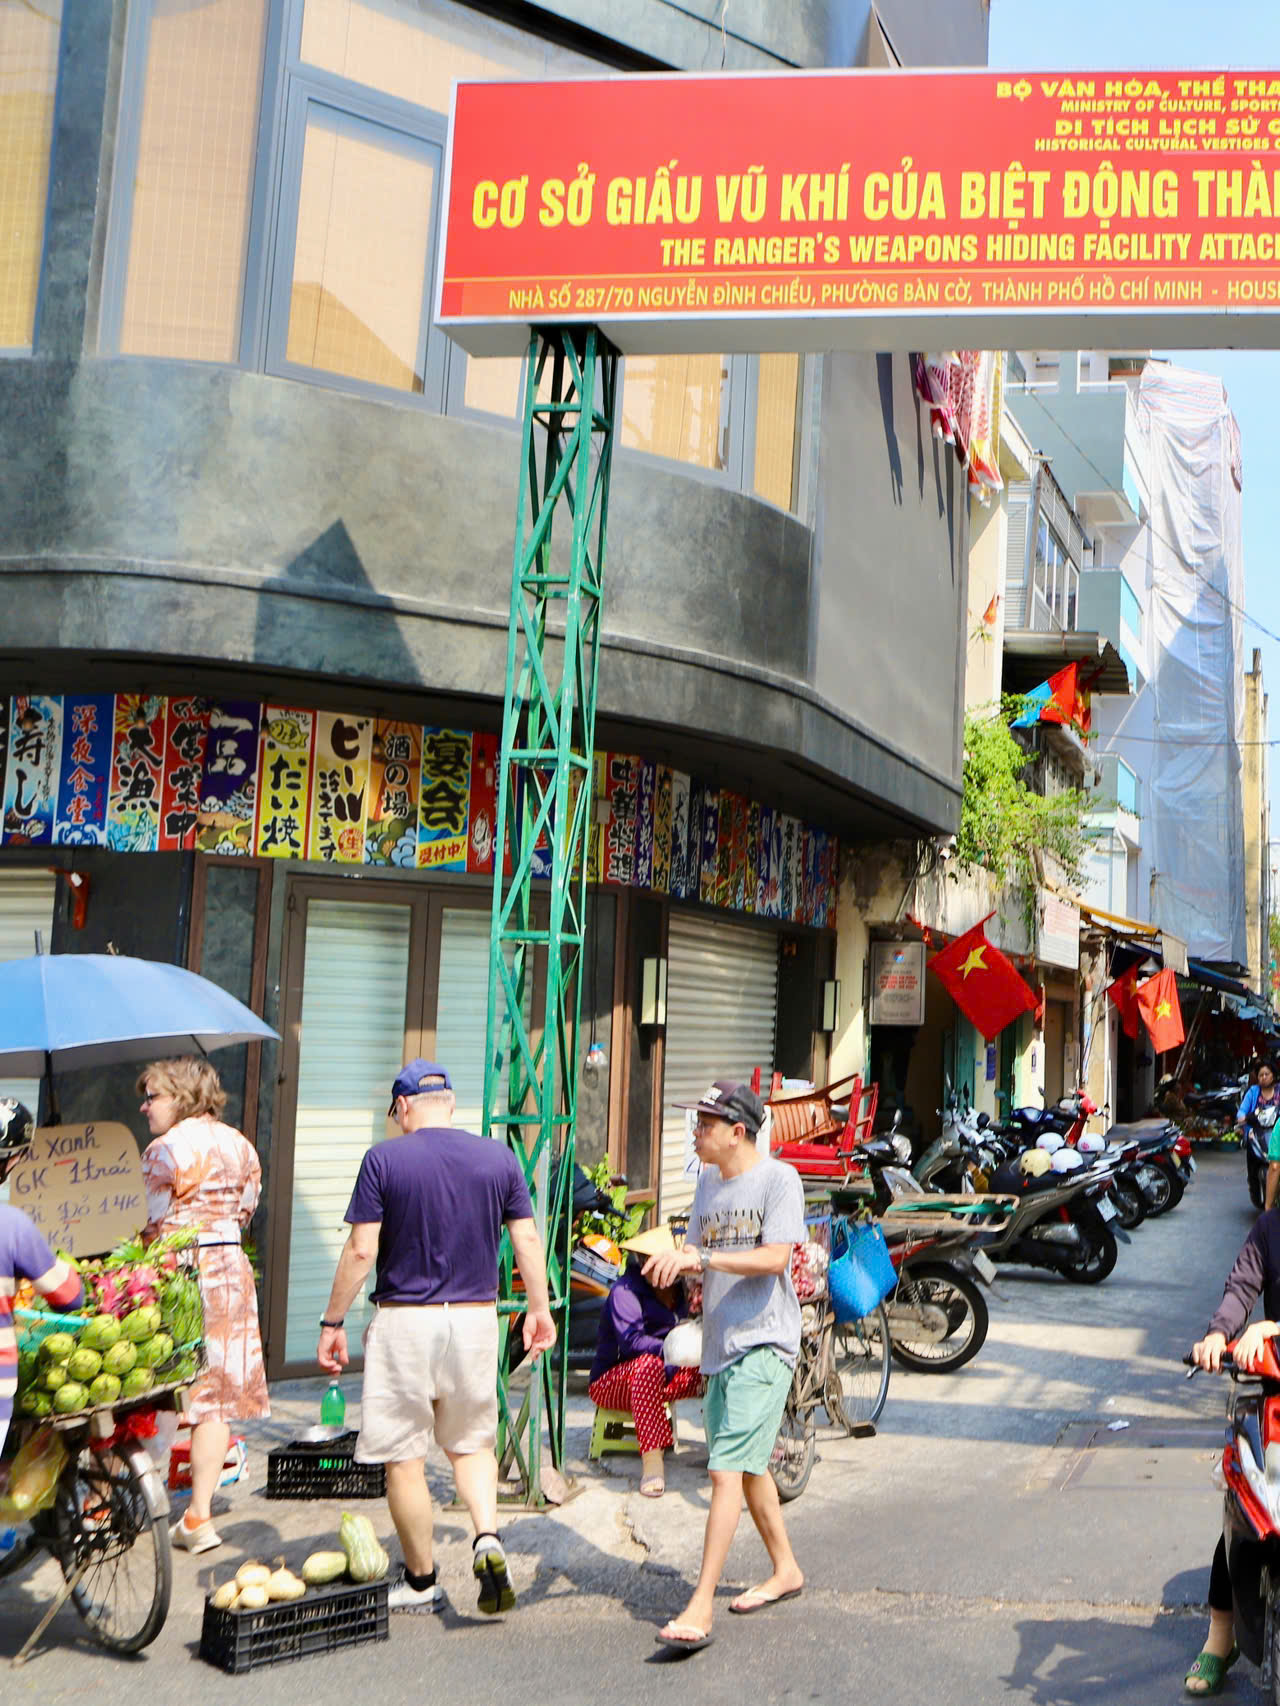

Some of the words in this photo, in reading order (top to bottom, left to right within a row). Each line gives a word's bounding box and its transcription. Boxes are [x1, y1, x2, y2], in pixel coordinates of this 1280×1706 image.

[1061, 99, 1131, 113] MINISTRY
[1135, 99, 1154, 113] OF
[1159, 99, 1226, 114] CULTURE,
[1035, 138, 1120, 151] HISTORICAL
[1125, 138, 1197, 151] CULTURAL
[1202, 137, 1269, 151] VESTIGES
[1055, 119, 1083, 136] DI
[1092, 115, 1149, 136] TÍCH
[1159, 119, 1216, 141] LỊCH
[472, 175, 529, 228] CƠ
[538, 162, 596, 227] SỞ
[606, 160, 702, 225] GIẤU
[716, 165, 768, 222] VŨ
[781, 163, 850, 222] KHÍ
[863, 157, 946, 221] CỦA
[960, 161, 1050, 228] BIỆT
[1062, 160, 1179, 228] ĐỘNG
[661, 238, 705, 266] THE
[714, 232, 840, 265] RANGER'S
[849, 235, 978, 263] WEAPONS
[987, 233, 1075, 262] HIDING
[1084, 233, 1191, 261] FACILITY
[509, 285, 544, 309] NHÀ
[548, 281, 571, 308] SỐ
[576, 286, 633, 308] 287/70
[638, 278, 708, 307] NGUYỄN
[713, 279, 757, 305] ĐÌNH
[821, 280, 898, 304] PHƯỜNG
[904, 278, 938, 302] BÀN
[983, 279, 1042, 301] THÀNH
[1047, 274, 1085, 300] PHỐ
[1090, 274, 1114, 299] HỒ
[1120, 275, 1149, 299] CHÍ
[1154, 279, 1202, 299] MINH
[66, 704, 98, 825] 深夜食堂
[381, 733, 412, 819] 酒の場
[420, 730, 472, 834] 宴会
